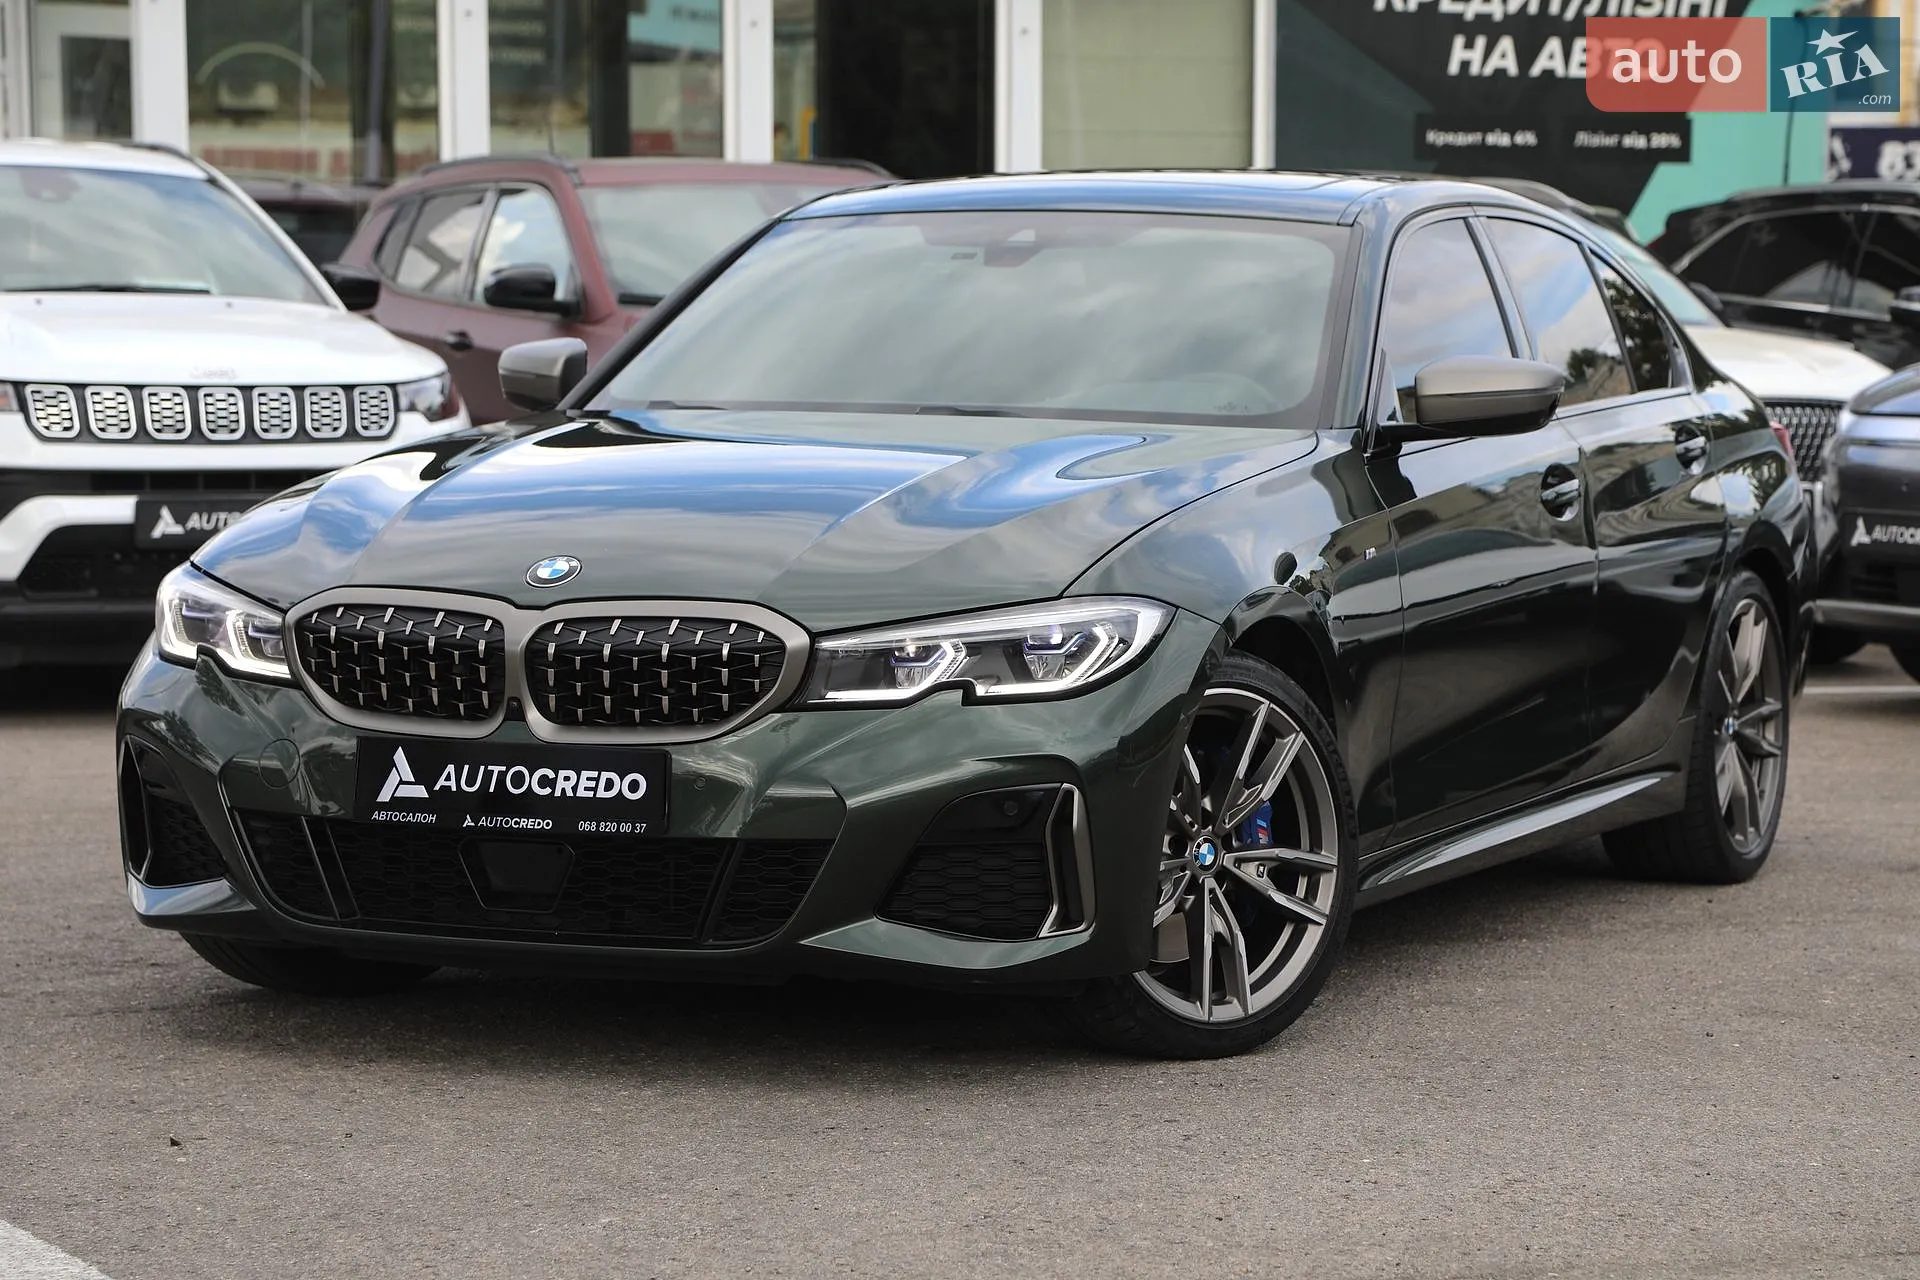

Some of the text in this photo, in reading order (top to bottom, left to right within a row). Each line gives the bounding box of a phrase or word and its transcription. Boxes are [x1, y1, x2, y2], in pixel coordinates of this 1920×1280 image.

[1447, 34, 1519, 77] НА
[432, 763, 647, 801] AUTOCREDO
[371, 811, 437, 824] АВТОСАЛОН
[478, 816, 553, 830] AUTOCREDO
[578, 820, 647, 834] 068 820 00 37
